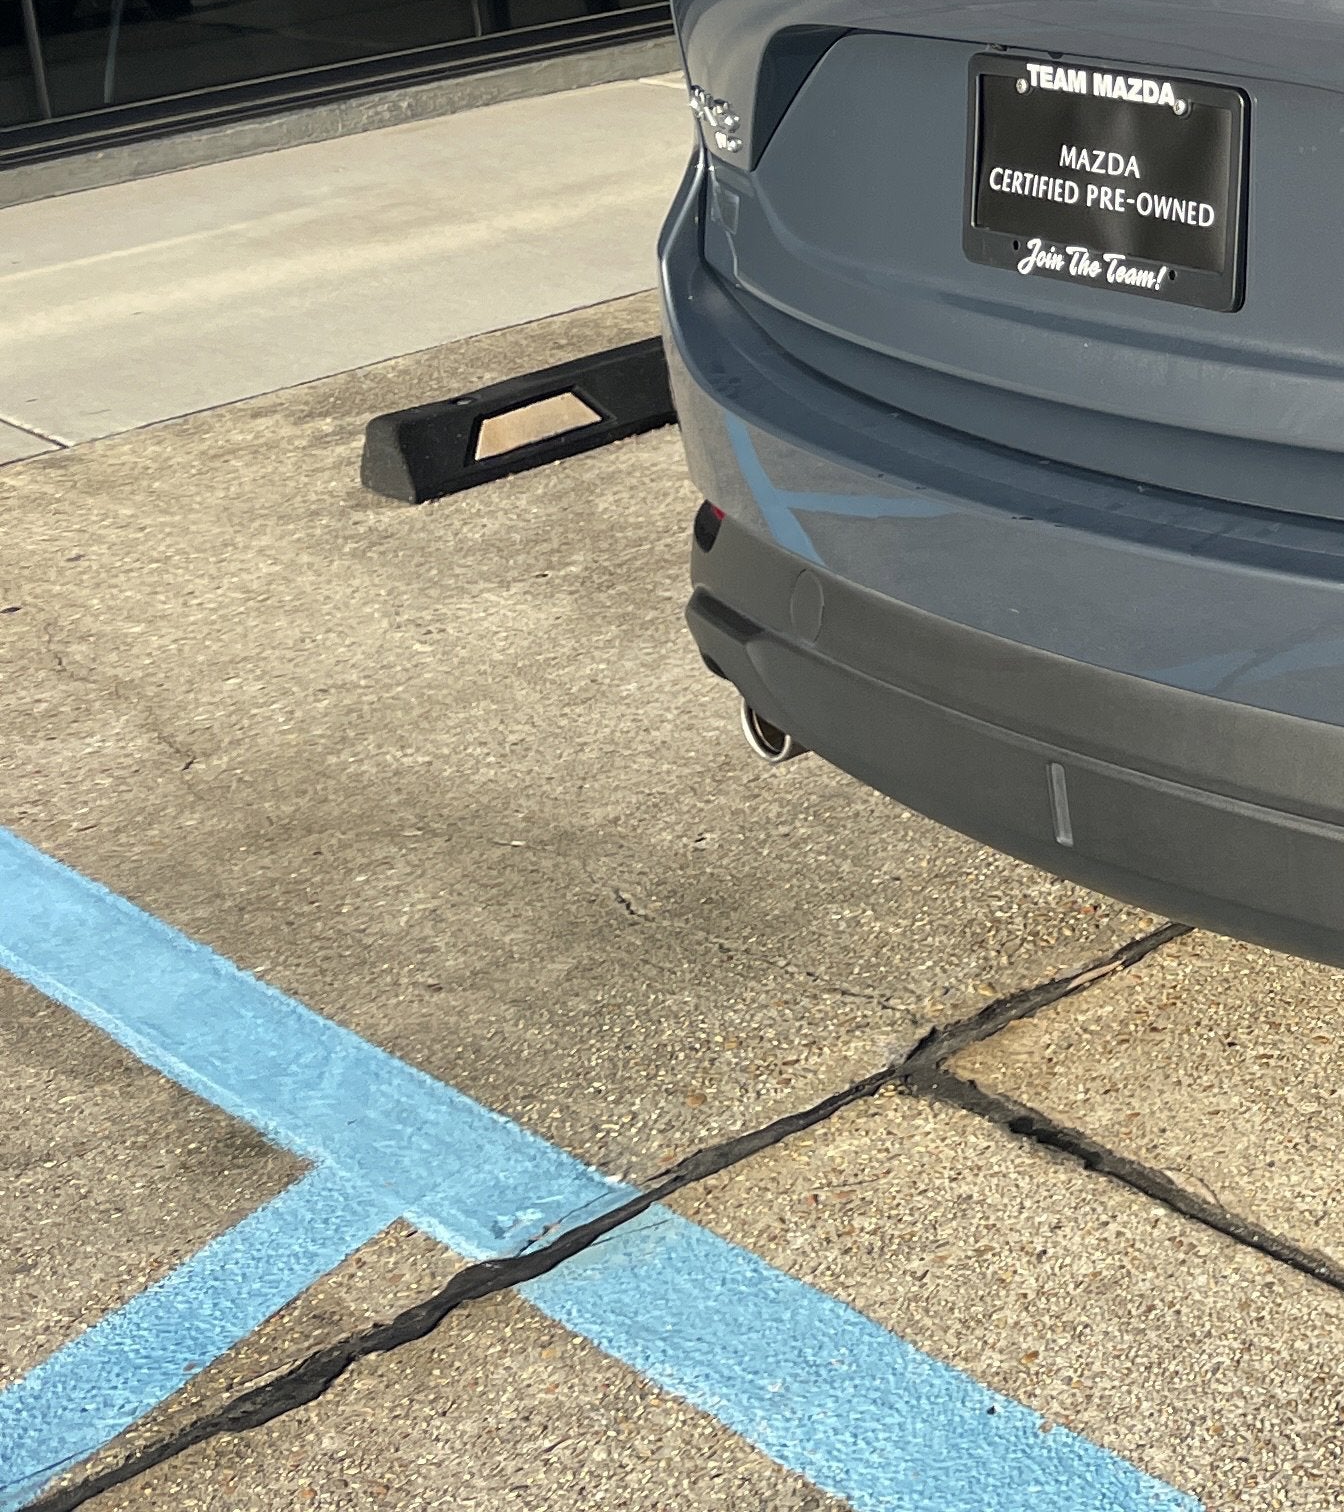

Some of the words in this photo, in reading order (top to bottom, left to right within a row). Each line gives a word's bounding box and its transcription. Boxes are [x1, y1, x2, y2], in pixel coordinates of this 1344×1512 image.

[1026, 63, 1087, 95] TEAM
[1093, 73, 1175, 106] MAZDA
[1059, 144, 1141, 179] MAZDA
[989, 167, 1079, 204] CERTIFIED
[1086, 184, 1215, 227] PRE-OWNED
[1017, 238, 1065, 275] Join
[1065, 246, 1102, 278] The
[1103, 253, 1167, 291] Team!
